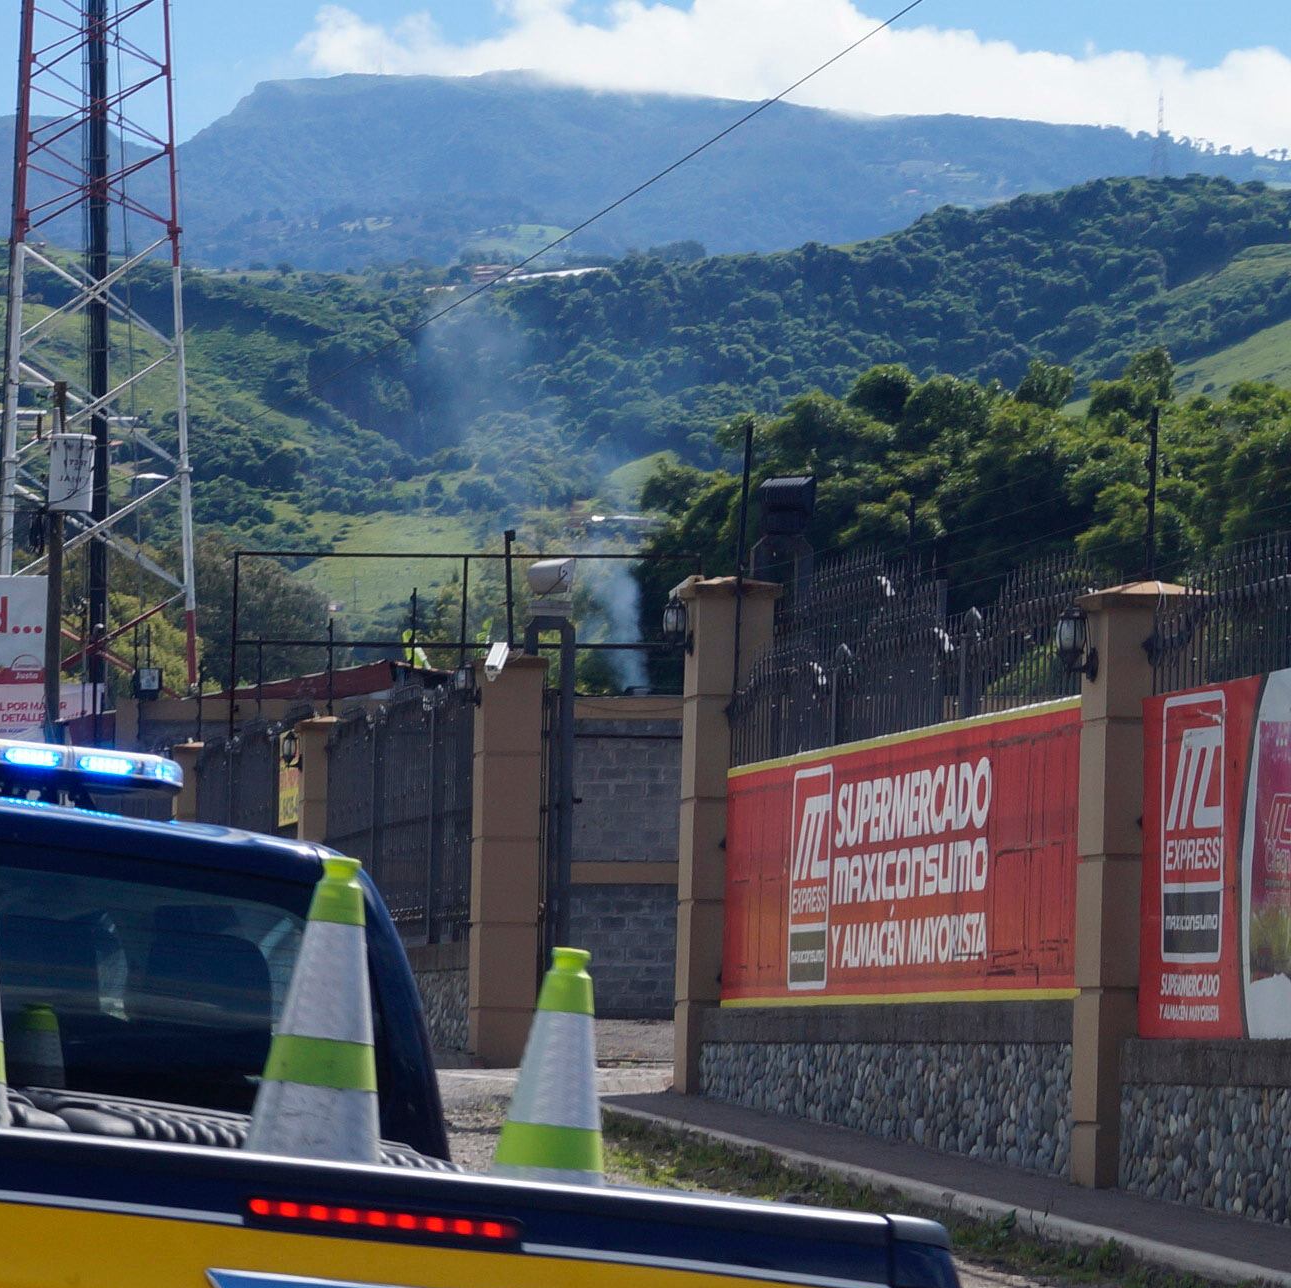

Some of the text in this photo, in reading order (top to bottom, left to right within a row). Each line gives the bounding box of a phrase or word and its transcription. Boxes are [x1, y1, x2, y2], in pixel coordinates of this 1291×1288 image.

[7, 702, 28, 711] POR
[30, 702, 67, 712] MAR
[835, 757, 992, 848] SUPERMERCADO
[1165, 837, 1220, 870] EXPRESS
[791, 885, 827, 914] EXPRESS
[831, 904, 987, 969] Y ALMACÉN MAYORISTA
[1160, 973, 1219, 996] SUPERMERCADO
